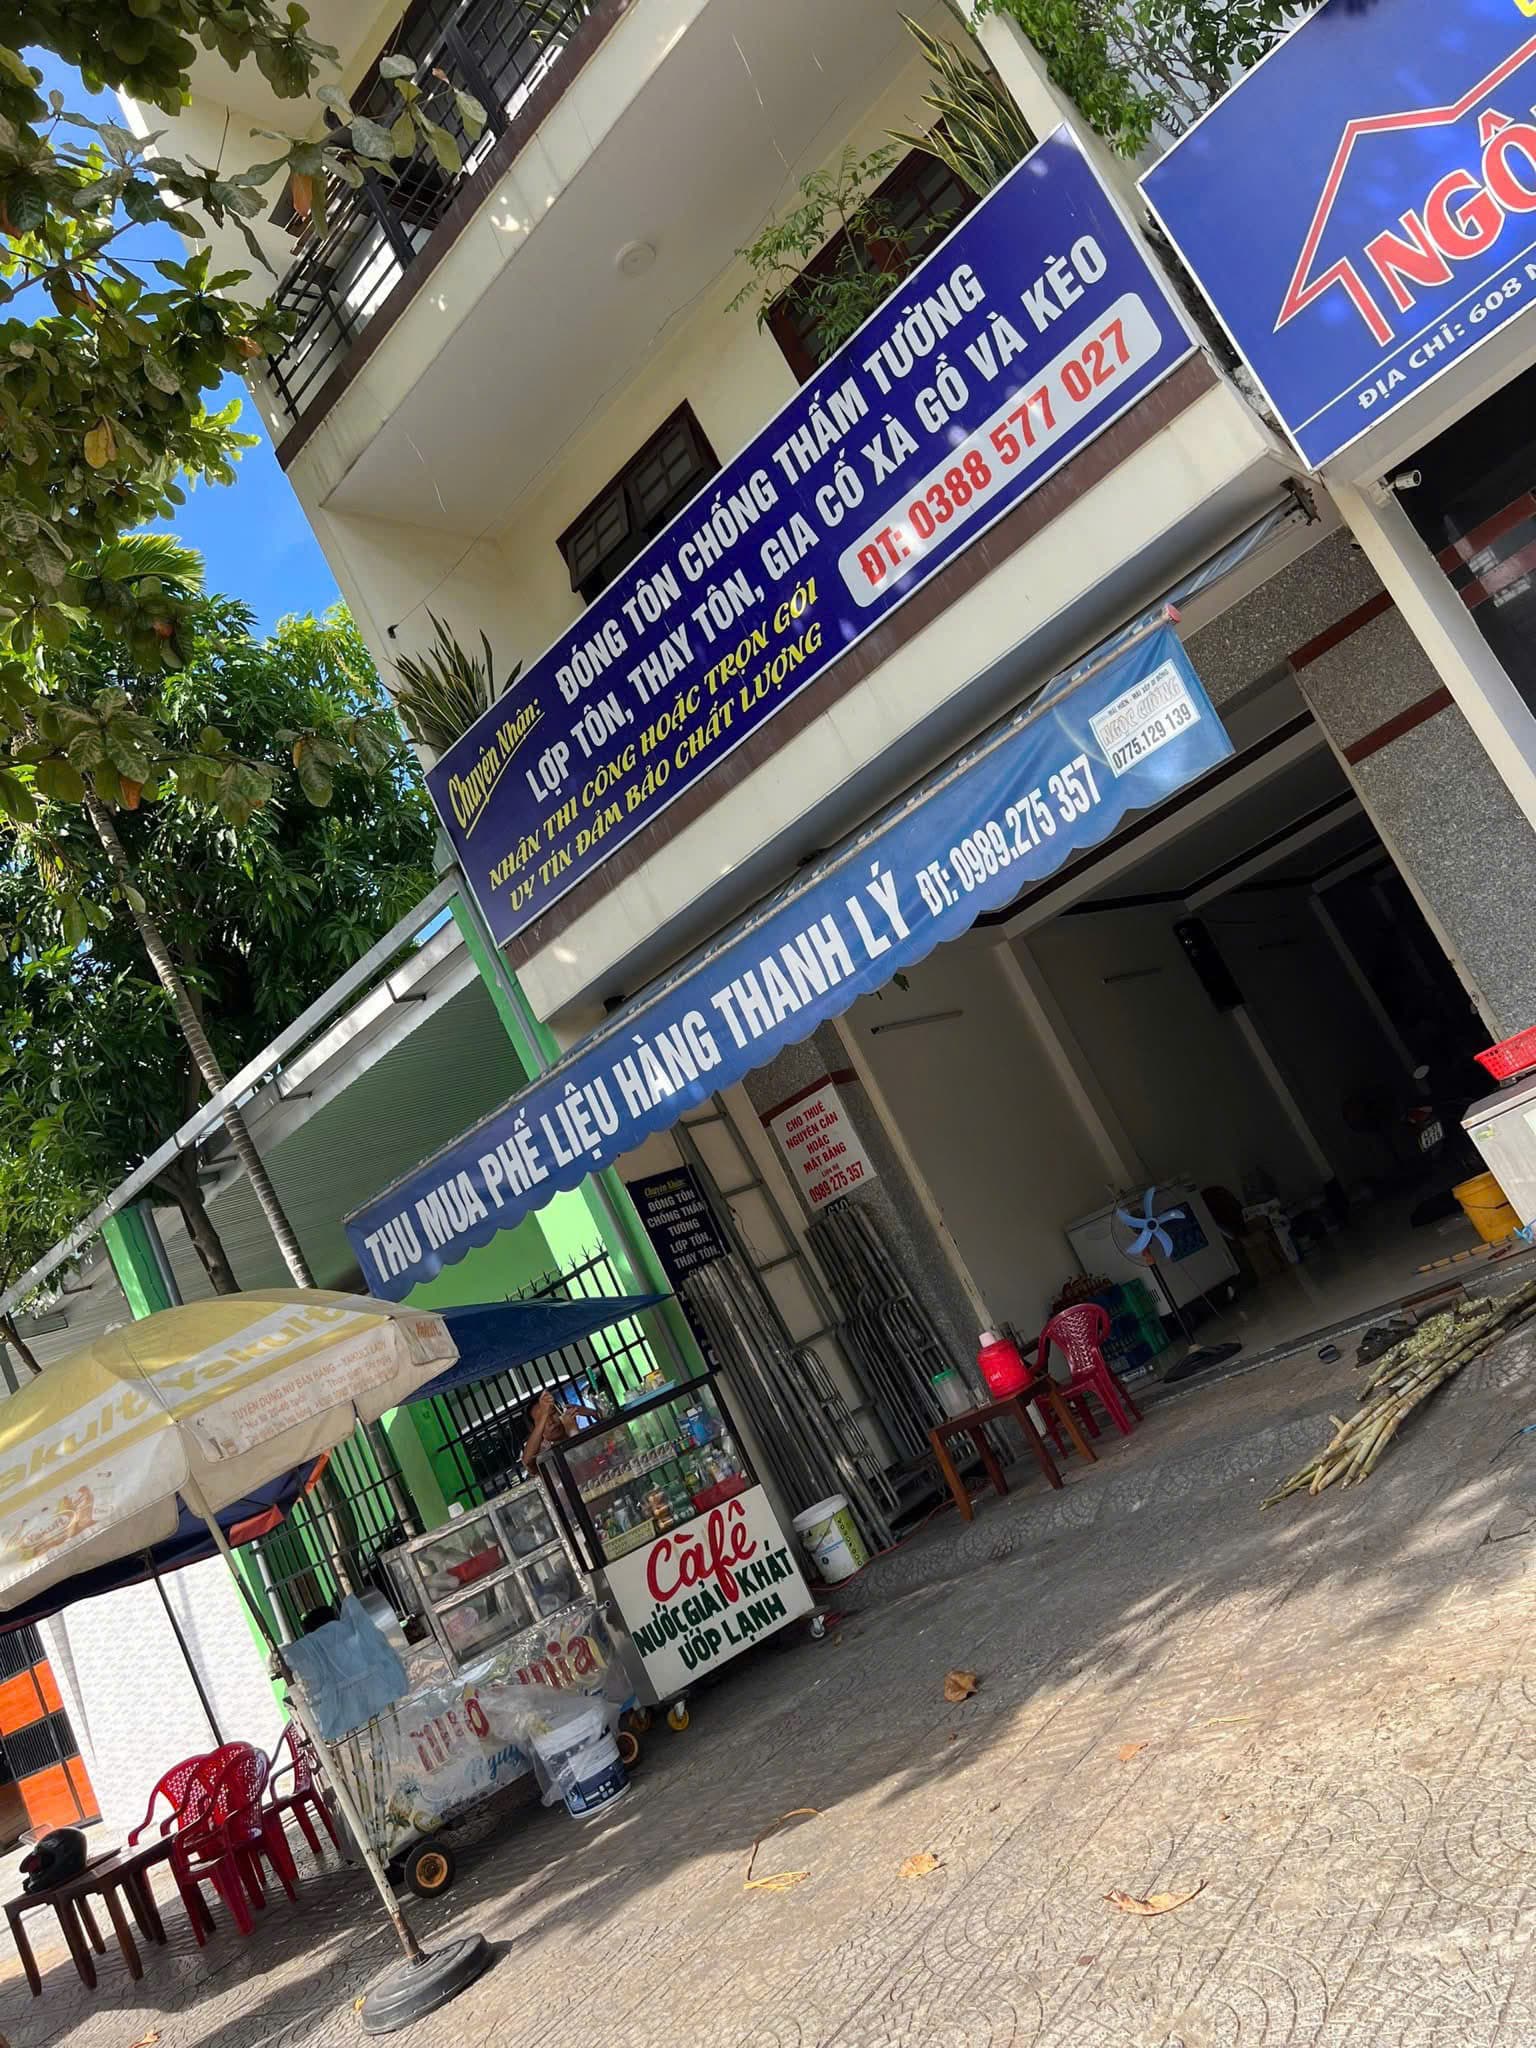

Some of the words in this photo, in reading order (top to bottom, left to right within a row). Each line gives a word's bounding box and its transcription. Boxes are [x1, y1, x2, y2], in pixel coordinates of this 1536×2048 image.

[1364, 104, 1536, 314] NGÔ
[1358, 369, 1407, 410] ĐỊA
[1408, 322, 1465, 371] CHỈ:
[1469, 277, 1522, 323] 608
[555, 613, 629, 704] ĐÓNG
[622, 564, 682, 635] TÔN
[677, 469, 779, 583] CHỐNG
[771, 376, 869, 486] THẤM
[862, 263, 986, 395] TƯỜNG
[857, 531, 911, 586] ĐT:
[908, 450, 992, 541] 0388
[989, 385, 1057, 465] 577
[1059, 318, 1131, 403] 027
[525, 740, 572, 802] LỢP
[571, 692, 634, 758] TÔN,
[627, 624, 695, 705] THAY
[692, 568, 765, 644] TÔN,
[759, 511, 820, 581] GIA
[814, 446, 865, 528] CỐ
[860, 412, 919, 486] XÀ
[914, 353, 969, 434] GỒ
[964, 311, 1029, 382] VÀ
[1020, 235, 1107, 333] KÈO
[487, 828, 541, 891] NHẬN
[543, 805, 579, 840] THI
[582, 745, 637, 809] CÔNG
[639, 686, 702, 755] HOẶC
[703, 629, 769, 696] TRỌN
[773, 577, 819, 635] GÓI
[538, 850, 573, 887] TÍN
[625, 758, 670, 812] BẢO
[675, 700, 735, 770] CHẤT
[739, 622, 823, 713] LƯỢNG
[1111, 720, 1167, 769] 0775.129
[1164, 703, 1192, 731] 139
[448, 746, 500, 829] Chuyên
[363, 1211, 422, 1283] THU
[415, 1171, 489, 1250] MUA
[479, 1108, 550, 1208] PHẾ
[538, 1082, 620, 1170] LIỆU
[611, 1010, 720, 1119] HÀNG
[710, 913, 857, 1049] THANH
[845, 860, 911, 960] LÝ
[914, 860, 959, 918] ĐT:
[949, 787, 1057, 892] 0989.275
[1048, 753, 1102, 823] 357
[785, 1113, 804, 1133] CHO
[803, 1099, 826, 1122] THUÊ
[808, 1174, 832, 1204] 0989
[829, 1168, 850, 1194] 275
[848, 1160, 866, 1185] 357
[674, 1251, 697, 1269] THAY
[160, 1306, 347, 1391] Yakult
[0, 1390, 150, 1493] akult
[632, 1603, 688, 1658] NƯỚC
[678, 1626, 723, 1671] ƯỚP
[721, 1592, 788, 1645] LẠNH
